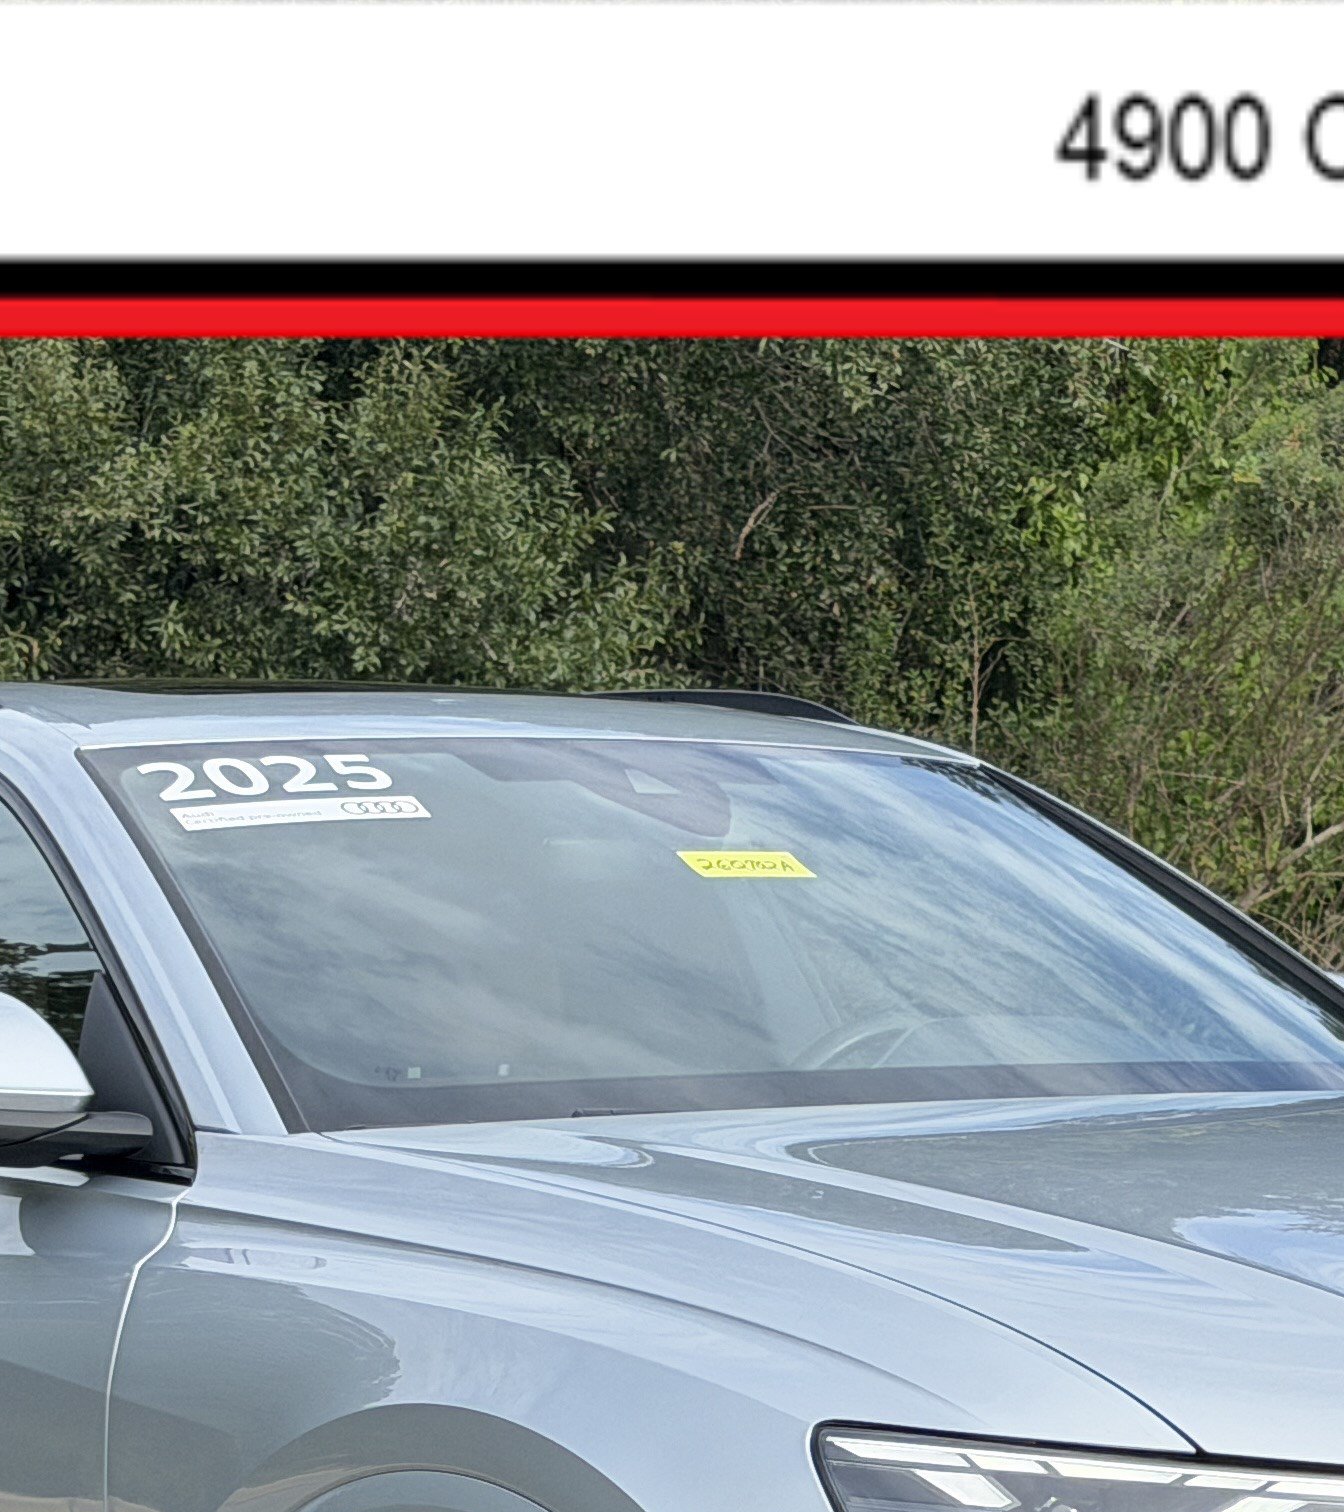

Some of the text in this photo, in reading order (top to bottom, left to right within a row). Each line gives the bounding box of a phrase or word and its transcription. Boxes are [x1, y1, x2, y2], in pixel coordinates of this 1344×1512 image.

[136, 753, 393, 801] 2025
[181, 811, 215, 820] Audi
[185, 815, 245, 825] Certified
